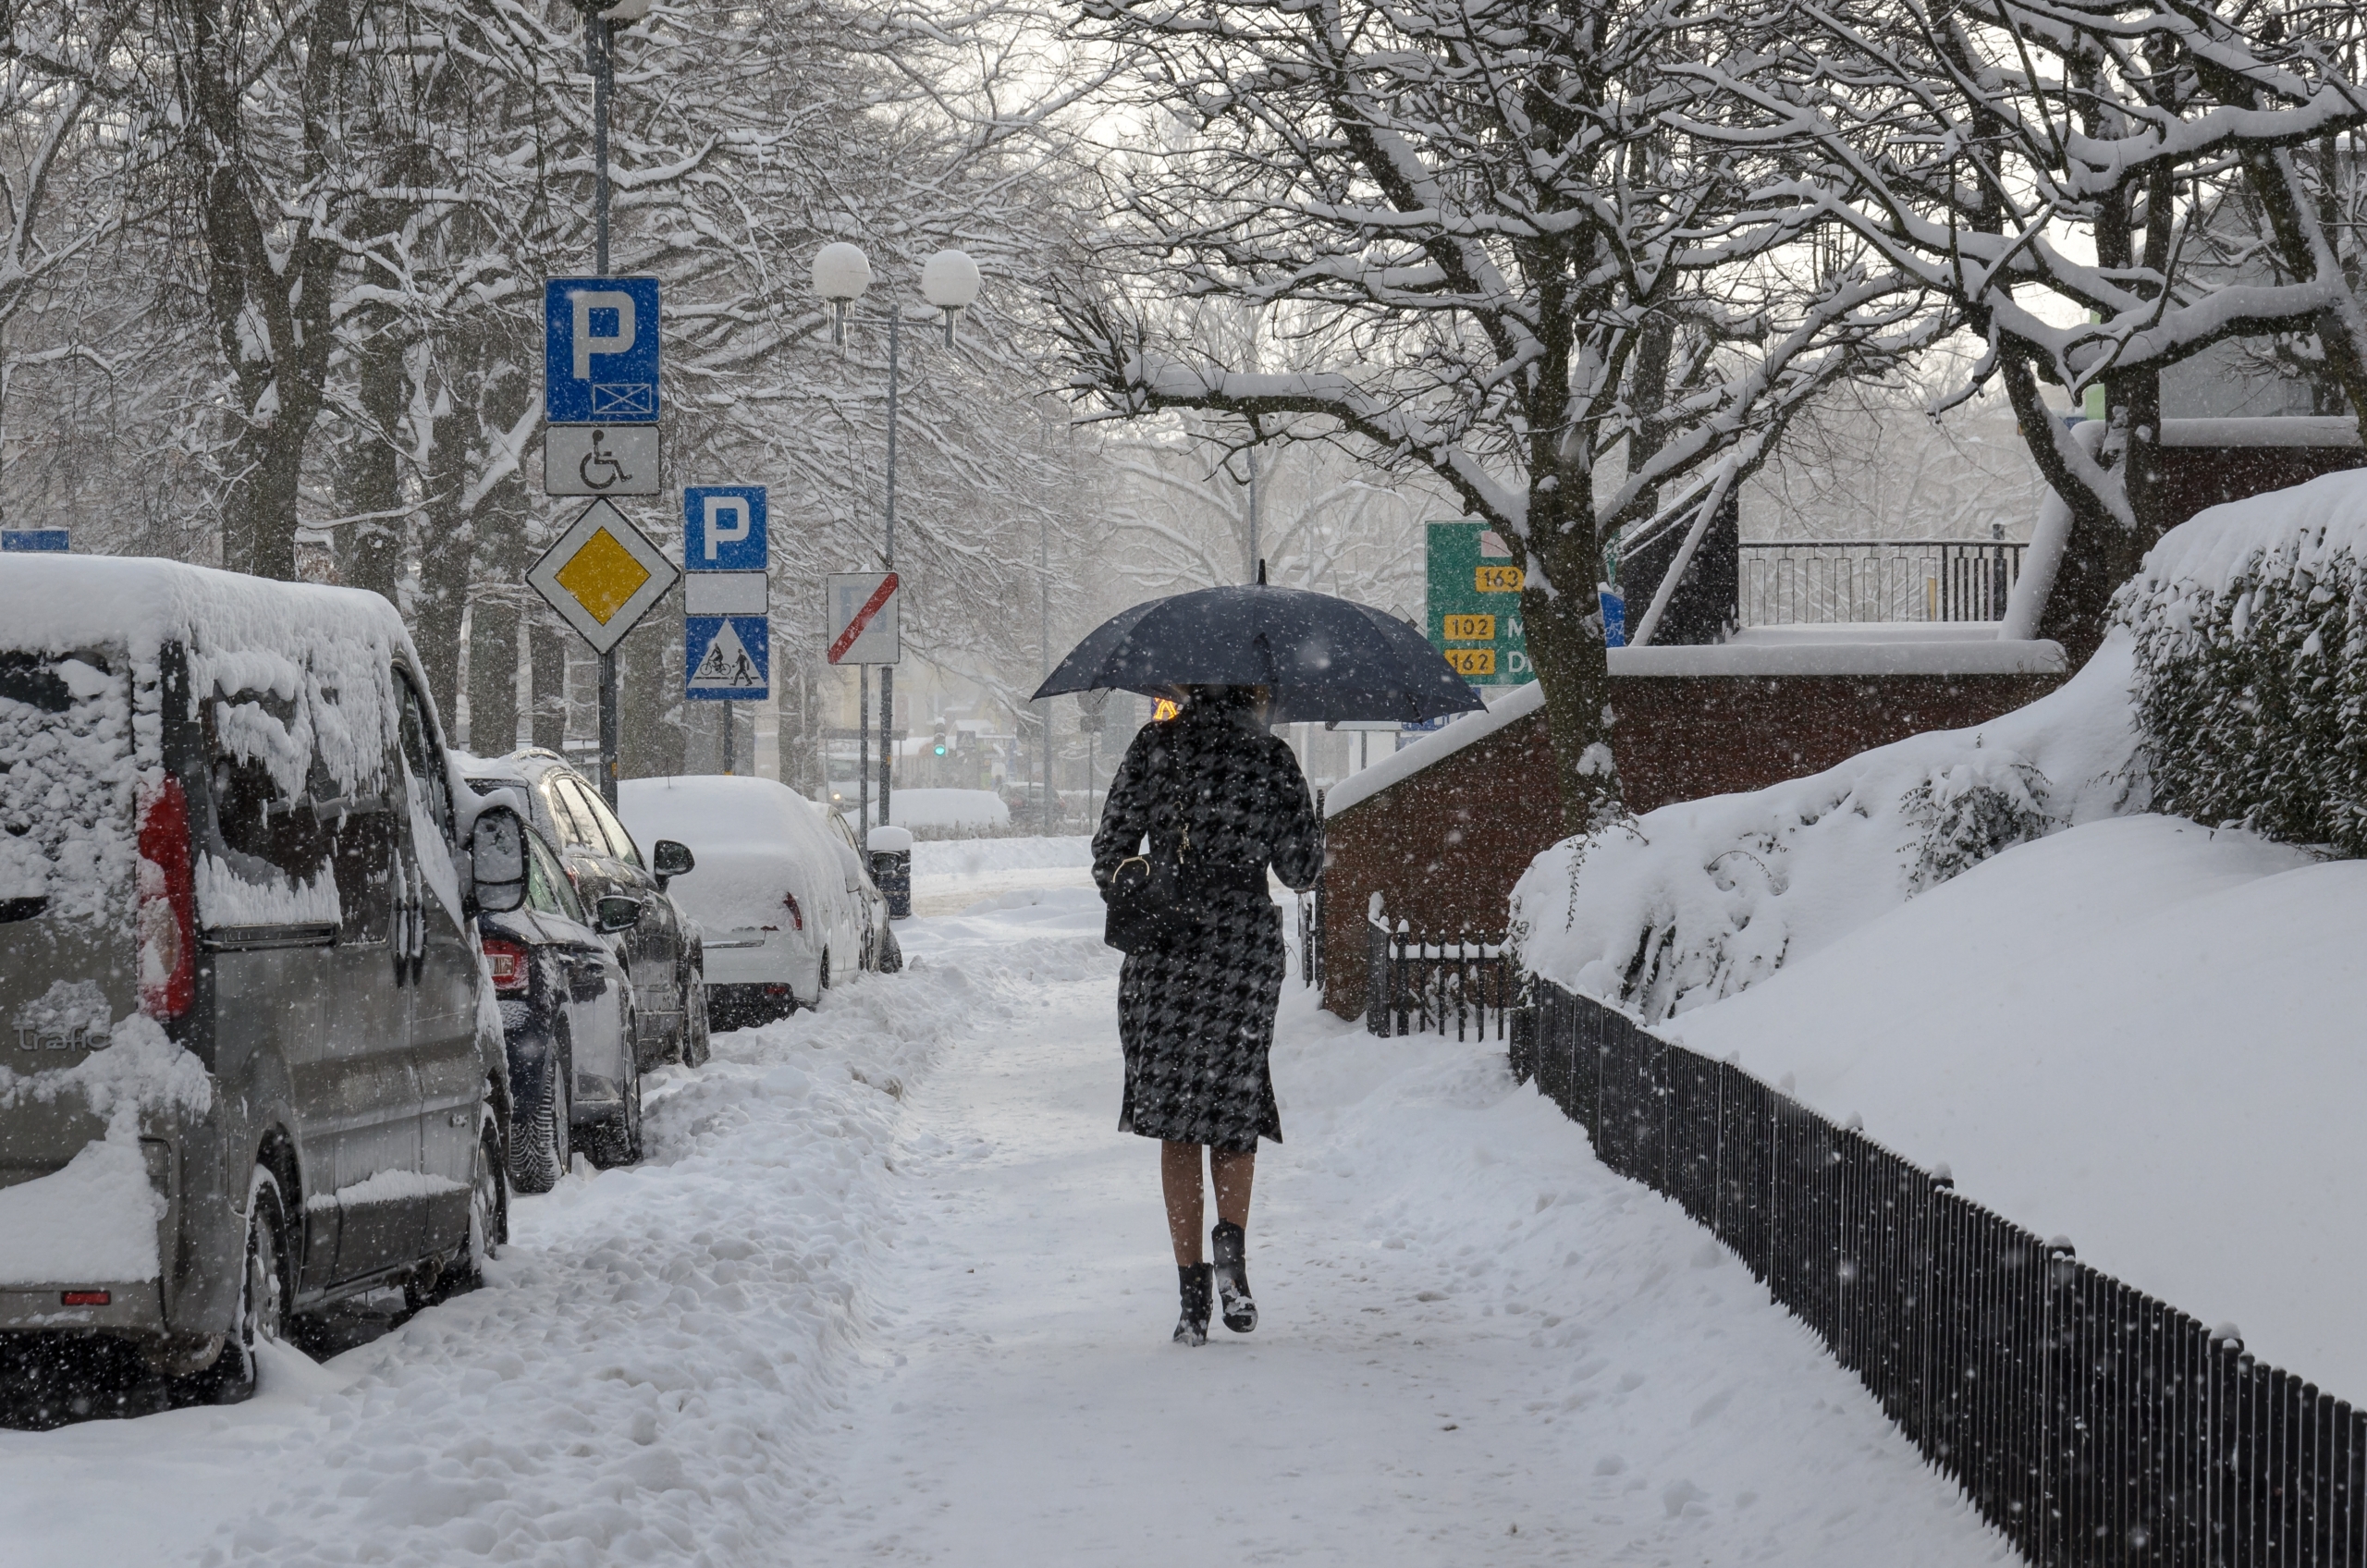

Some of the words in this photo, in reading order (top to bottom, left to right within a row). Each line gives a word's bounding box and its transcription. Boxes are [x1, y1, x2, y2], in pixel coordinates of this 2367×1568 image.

[572, 291, 635, 379] P
[704, 496, 750, 560] P
[1484, 570, 1518, 588] 163
[1452, 619, 1489, 636] 102
[1452, 653, 1489, 671] 162
